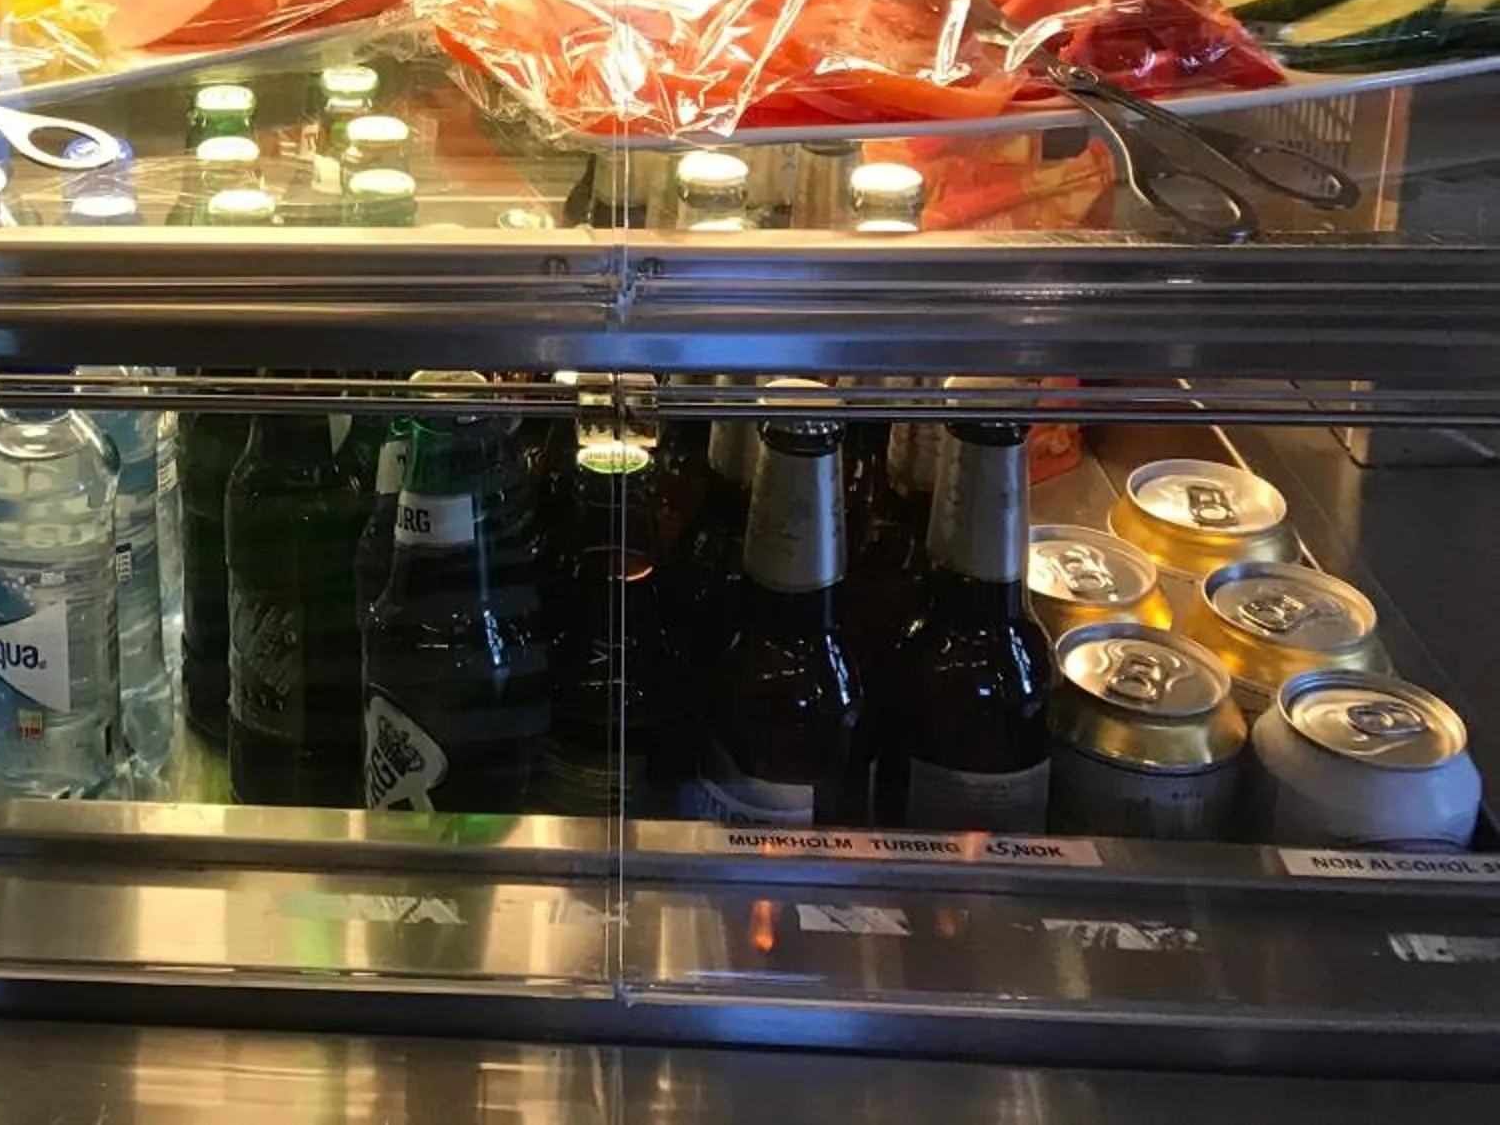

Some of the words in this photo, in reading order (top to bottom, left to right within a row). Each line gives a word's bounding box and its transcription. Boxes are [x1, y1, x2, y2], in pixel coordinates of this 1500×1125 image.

[729, 834, 853, 850] MUNKHOLM
[1311, 856, 1364, 871] NON
[1369, 858, 1478, 874] ALCOHOL
